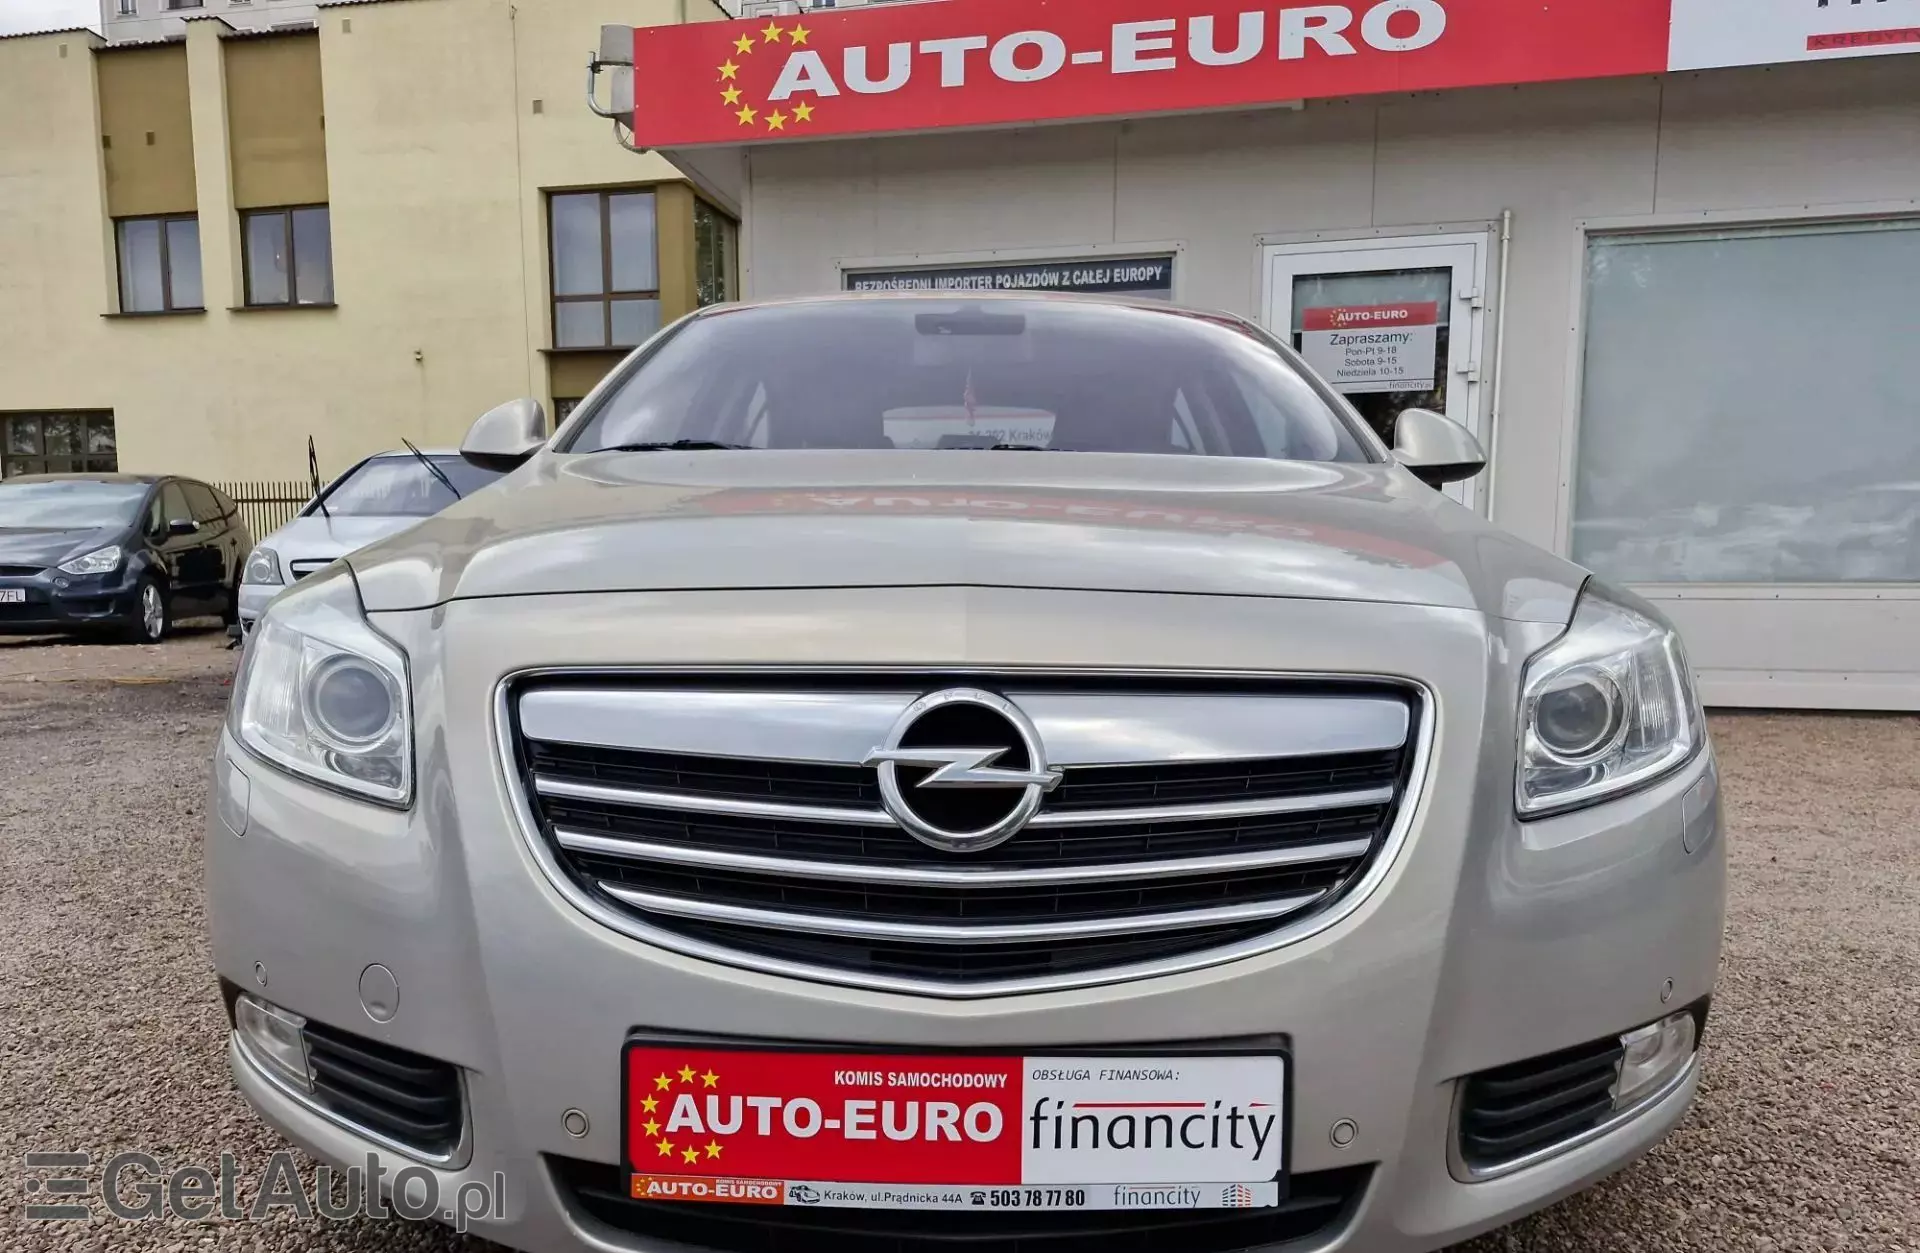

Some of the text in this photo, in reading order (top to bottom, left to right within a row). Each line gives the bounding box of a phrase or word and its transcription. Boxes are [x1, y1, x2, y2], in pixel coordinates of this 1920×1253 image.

[767, 0, 1446, 100] AUTO-EURO
[935, 275, 994, 289] IMPORTER
[996, 269, 1060, 288] POJAZDÓW
[1062, 271, 1070, 286] Z
[1073, 269, 1110, 285] CAŁEJ
[1114, 265, 1163, 283] EUROPY
[1337, 309, 1408, 322] AUTO-EURO
[1330, 332, 1413, 347] Zapraszamy:
[1377, 345, 1397, 355] 9-18
[1344, 356, 1397, 367] Sobota 9-15
[1336, 366, 1404, 377] Niedziela 10-15
[834, 1070, 1009, 1089] KOMIS SAMOCHODOWY
[1032, 1069, 1181, 1082] OBSŁUGA FINANSOWA:
[665, 1094, 1004, 1143] AUTO-EURO
[1029, 1097, 1276, 1161] financity
[646, 1181, 779, 1200] AUTO-EURO
[871, 1190, 939, 1205] ul.Prądnicka
[941, 1193, 963, 1204] 44A
[990, 1189, 1085, 1207] 503 78 77 80
[1113, 1185, 1201, 1208] financity
